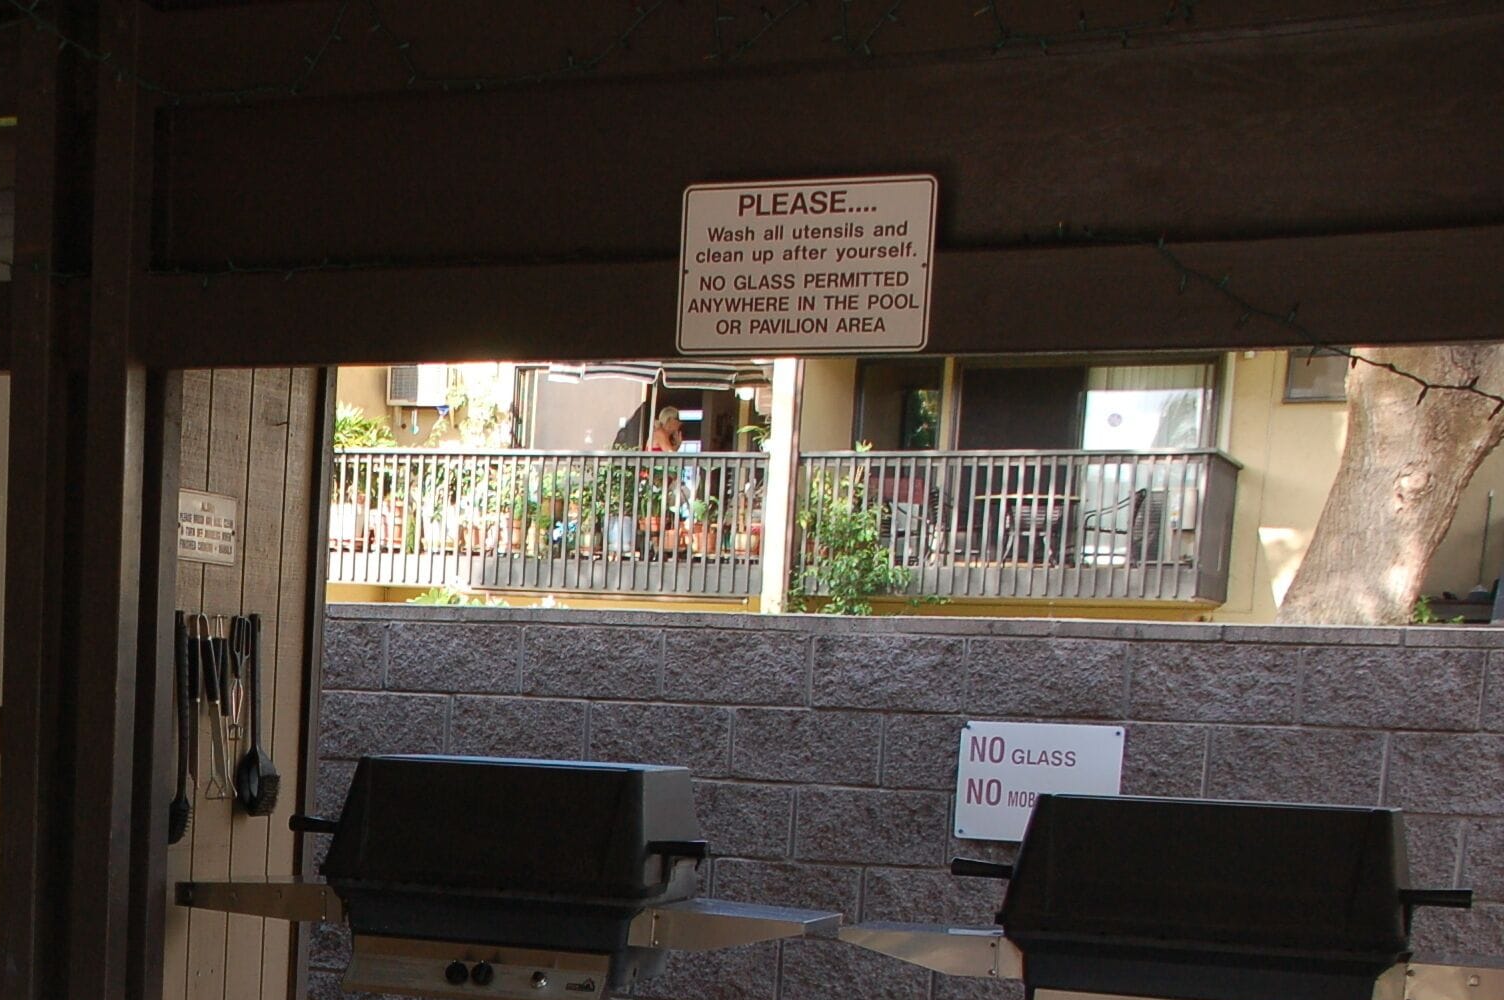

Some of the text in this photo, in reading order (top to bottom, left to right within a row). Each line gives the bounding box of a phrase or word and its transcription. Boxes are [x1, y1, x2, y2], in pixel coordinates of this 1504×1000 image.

[738, 190, 877, 216] PLEASE....
[708, 221, 907, 242] Wash all utensils and
[696, 242, 917, 265] clean up after yourself.
[700, 271, 909, 291] NO GLASS PERMITTED
[688, 294, 919, 313] ANYWHERE IN THE POOL
[716, 317, 885, 334] OR PAVILION AREA
[970, 736, 1076, 767] NO GLASS
[966, 778, 1038, 808] NO MOB
